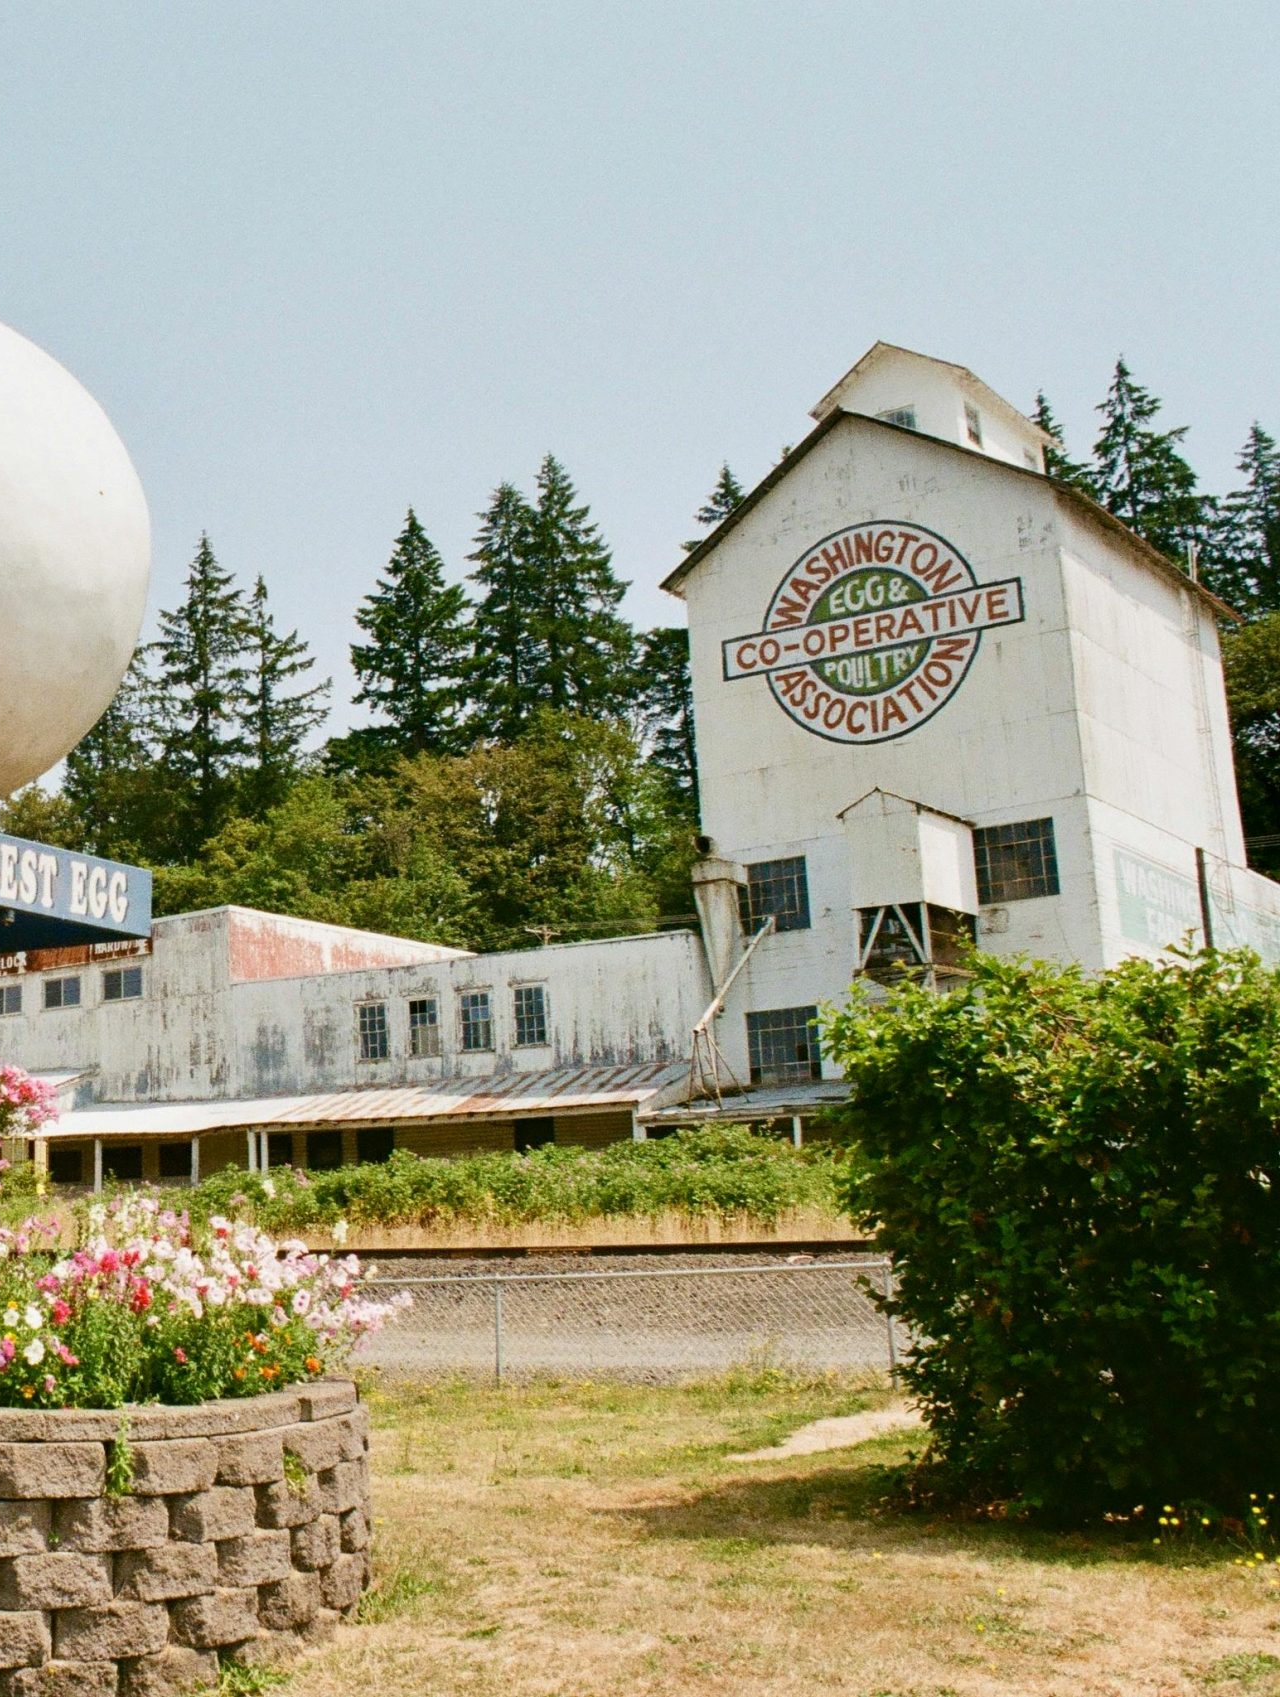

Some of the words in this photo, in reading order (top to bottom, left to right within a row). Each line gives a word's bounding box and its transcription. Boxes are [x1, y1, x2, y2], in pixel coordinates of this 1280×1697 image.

[771, 530, 963, 629] WASHINGTON
[829, 576, 885, 615] EGG
[888, 577, 909, 602] &
[735, 588, 1010, 671] CO-OPERATIVE
[775, 637, 970, 734] ASSOCIATION
[824, 645, 919, 688] POULTRY
[70, 861, 129, 923] EGG
